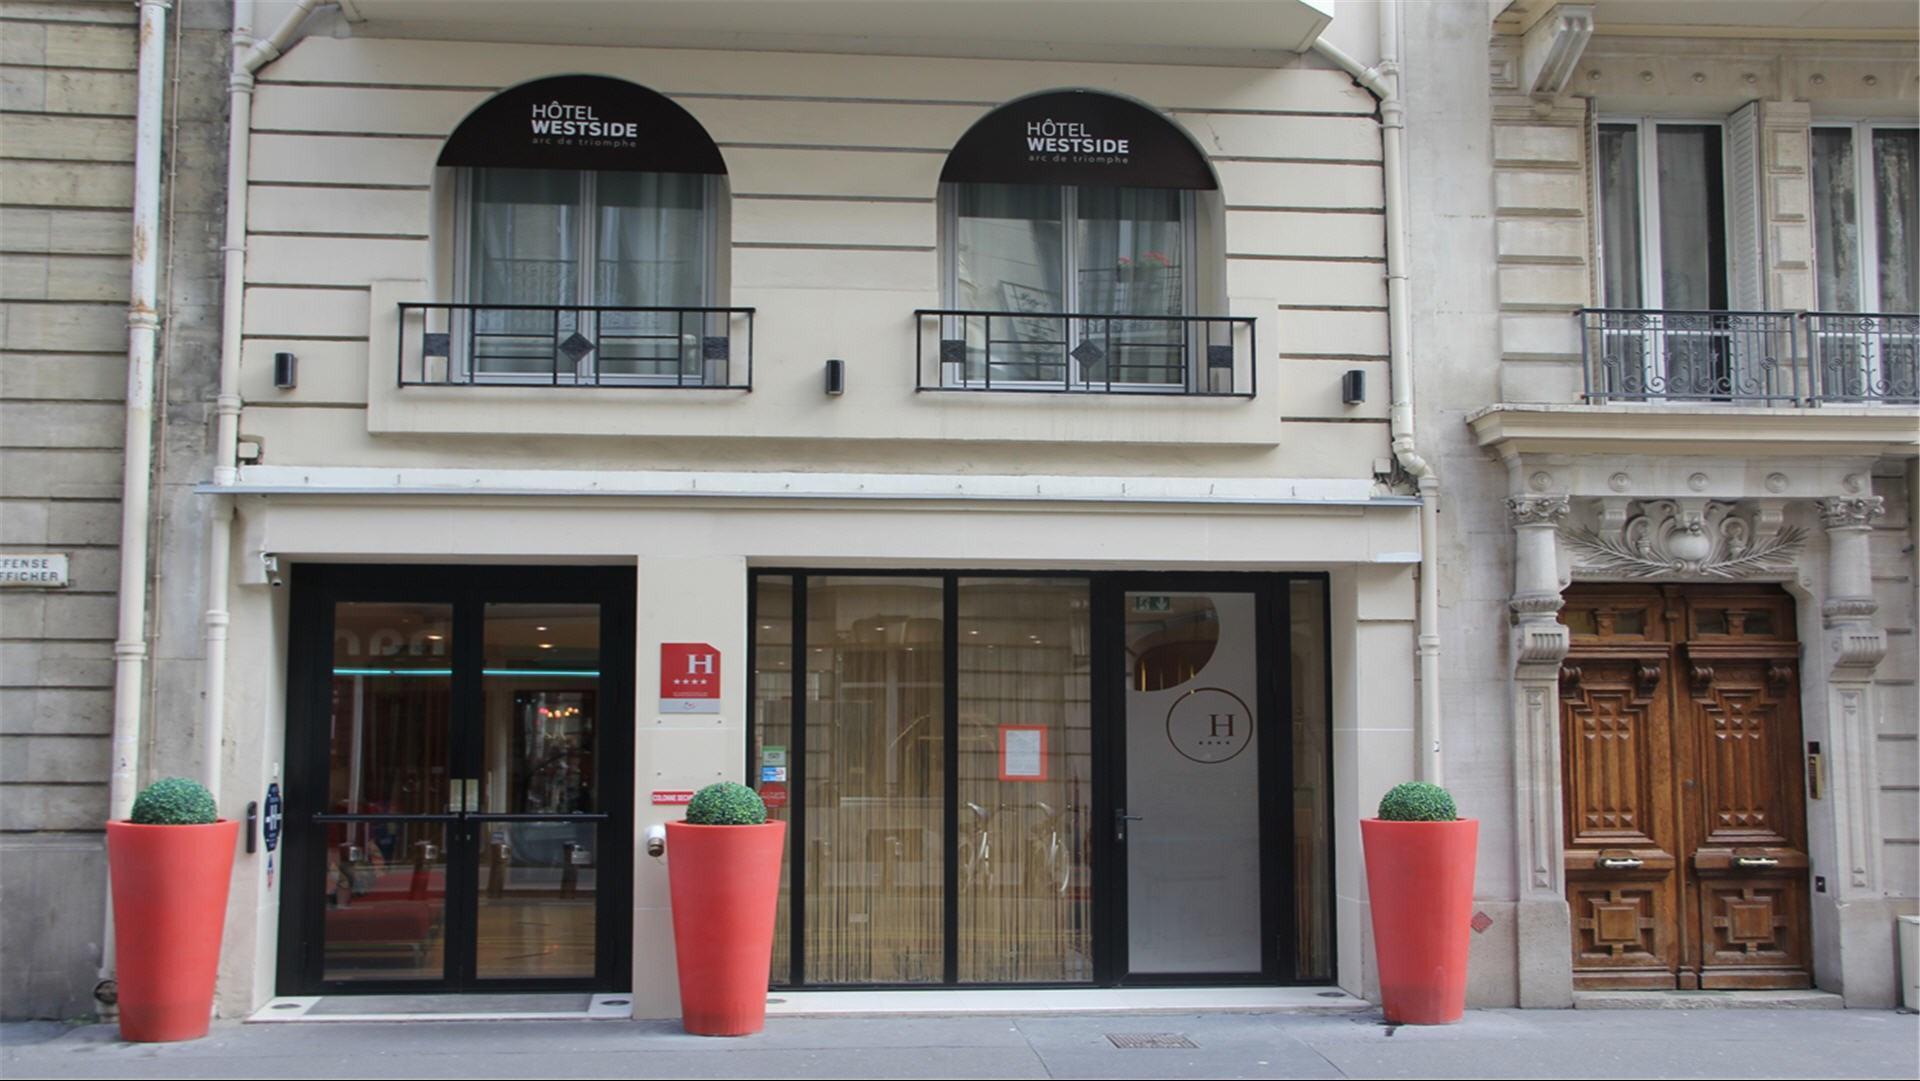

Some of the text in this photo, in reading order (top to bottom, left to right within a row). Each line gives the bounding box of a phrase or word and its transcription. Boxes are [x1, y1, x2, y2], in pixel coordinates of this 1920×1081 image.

[531, 100, 599, 120] HÔTEL
[531, 119, 639, 138] WESTSIDE
[1026, 118, 1092, 138] HÔTEL
[531, 137, 638, 149] arc de triomphe
[1026, 137, 1130, 154] WESTSIDE
[1028, 154, 1130, 166] arc de triomphe
[0, 558, 50, 569] FENSE
[686, 653, 715, 675] H
[1208, 714, 1237, 738] H
